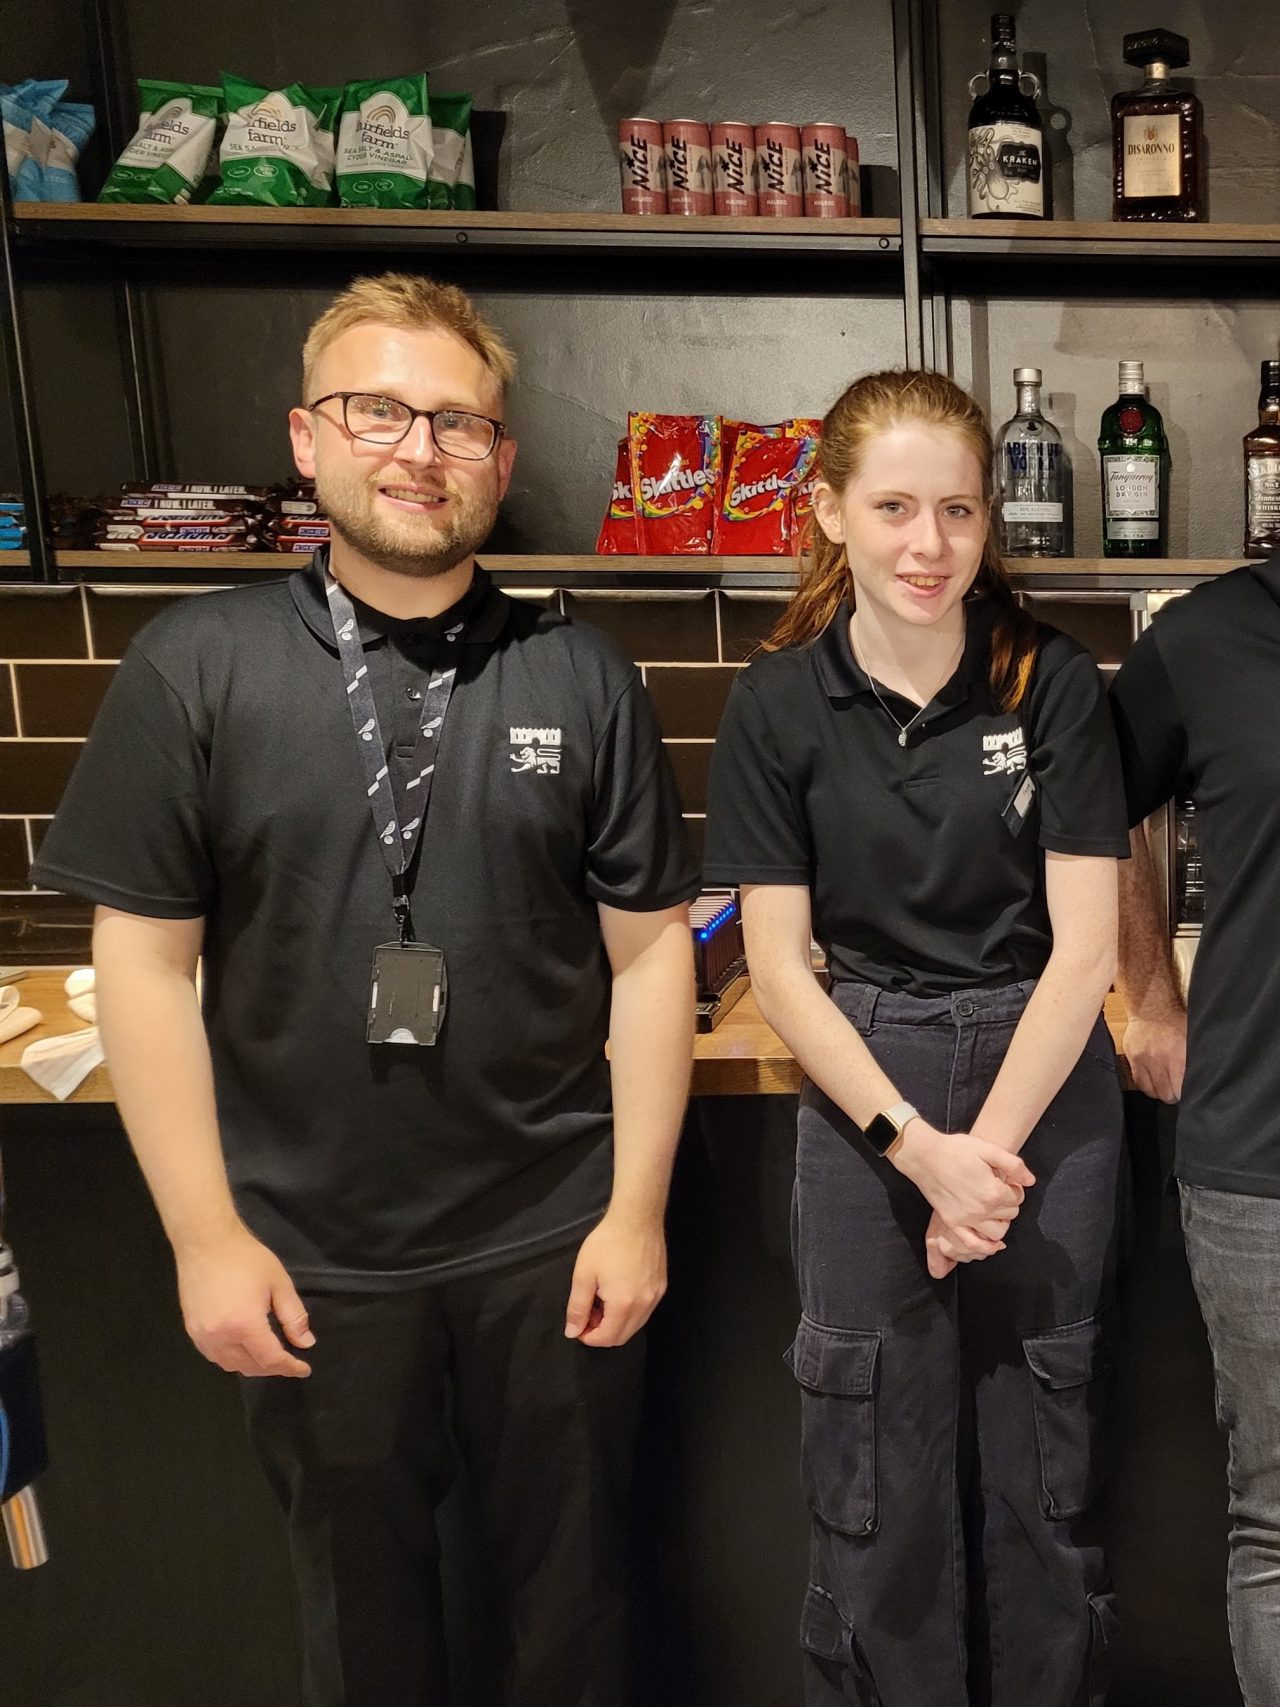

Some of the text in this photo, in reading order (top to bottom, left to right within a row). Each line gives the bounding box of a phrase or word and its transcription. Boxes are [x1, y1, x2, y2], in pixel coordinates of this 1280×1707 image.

[248, 128, 284, 146] farm
[361, 131, 396, 150] farm
[1127, 143, 1176, 156] DISARONNO
[1002, 155, 1038, 166] KRAKEN
